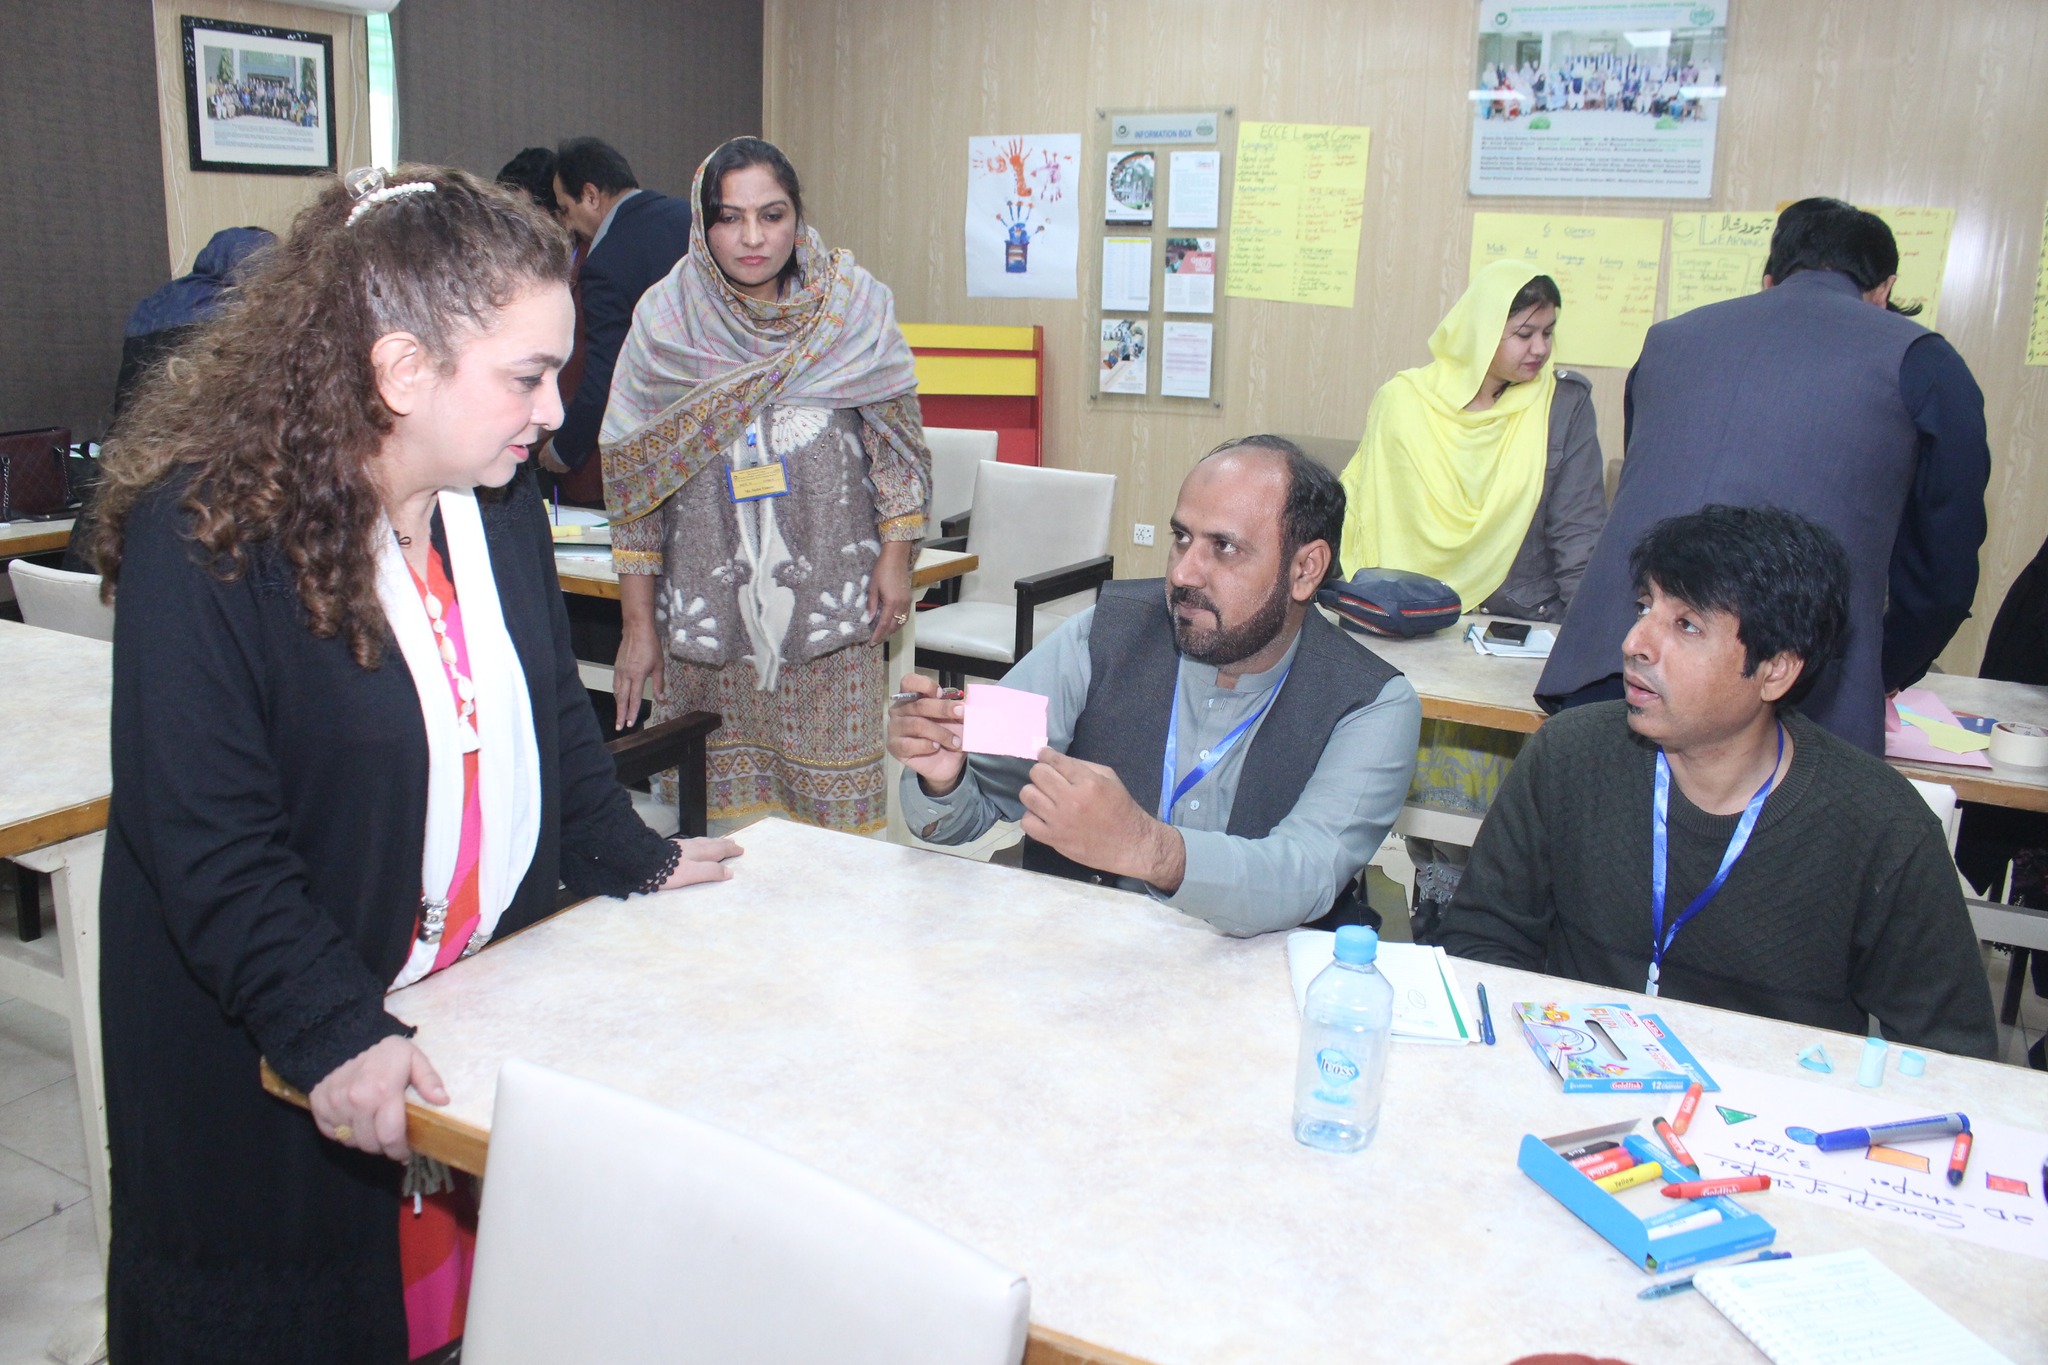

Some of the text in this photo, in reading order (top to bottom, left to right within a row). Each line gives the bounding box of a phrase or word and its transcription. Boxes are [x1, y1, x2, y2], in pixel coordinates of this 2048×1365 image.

[1135, 129, 1192, 138] INFORMATION BOX
[1611, 1081, 1642, 1090] Goldfish
[1652, 1081, 1661, 1090] 12
[1613, 1175, 1635, 1189] Yellow
[1702, 1185, 1739, 1197] Goldfish
